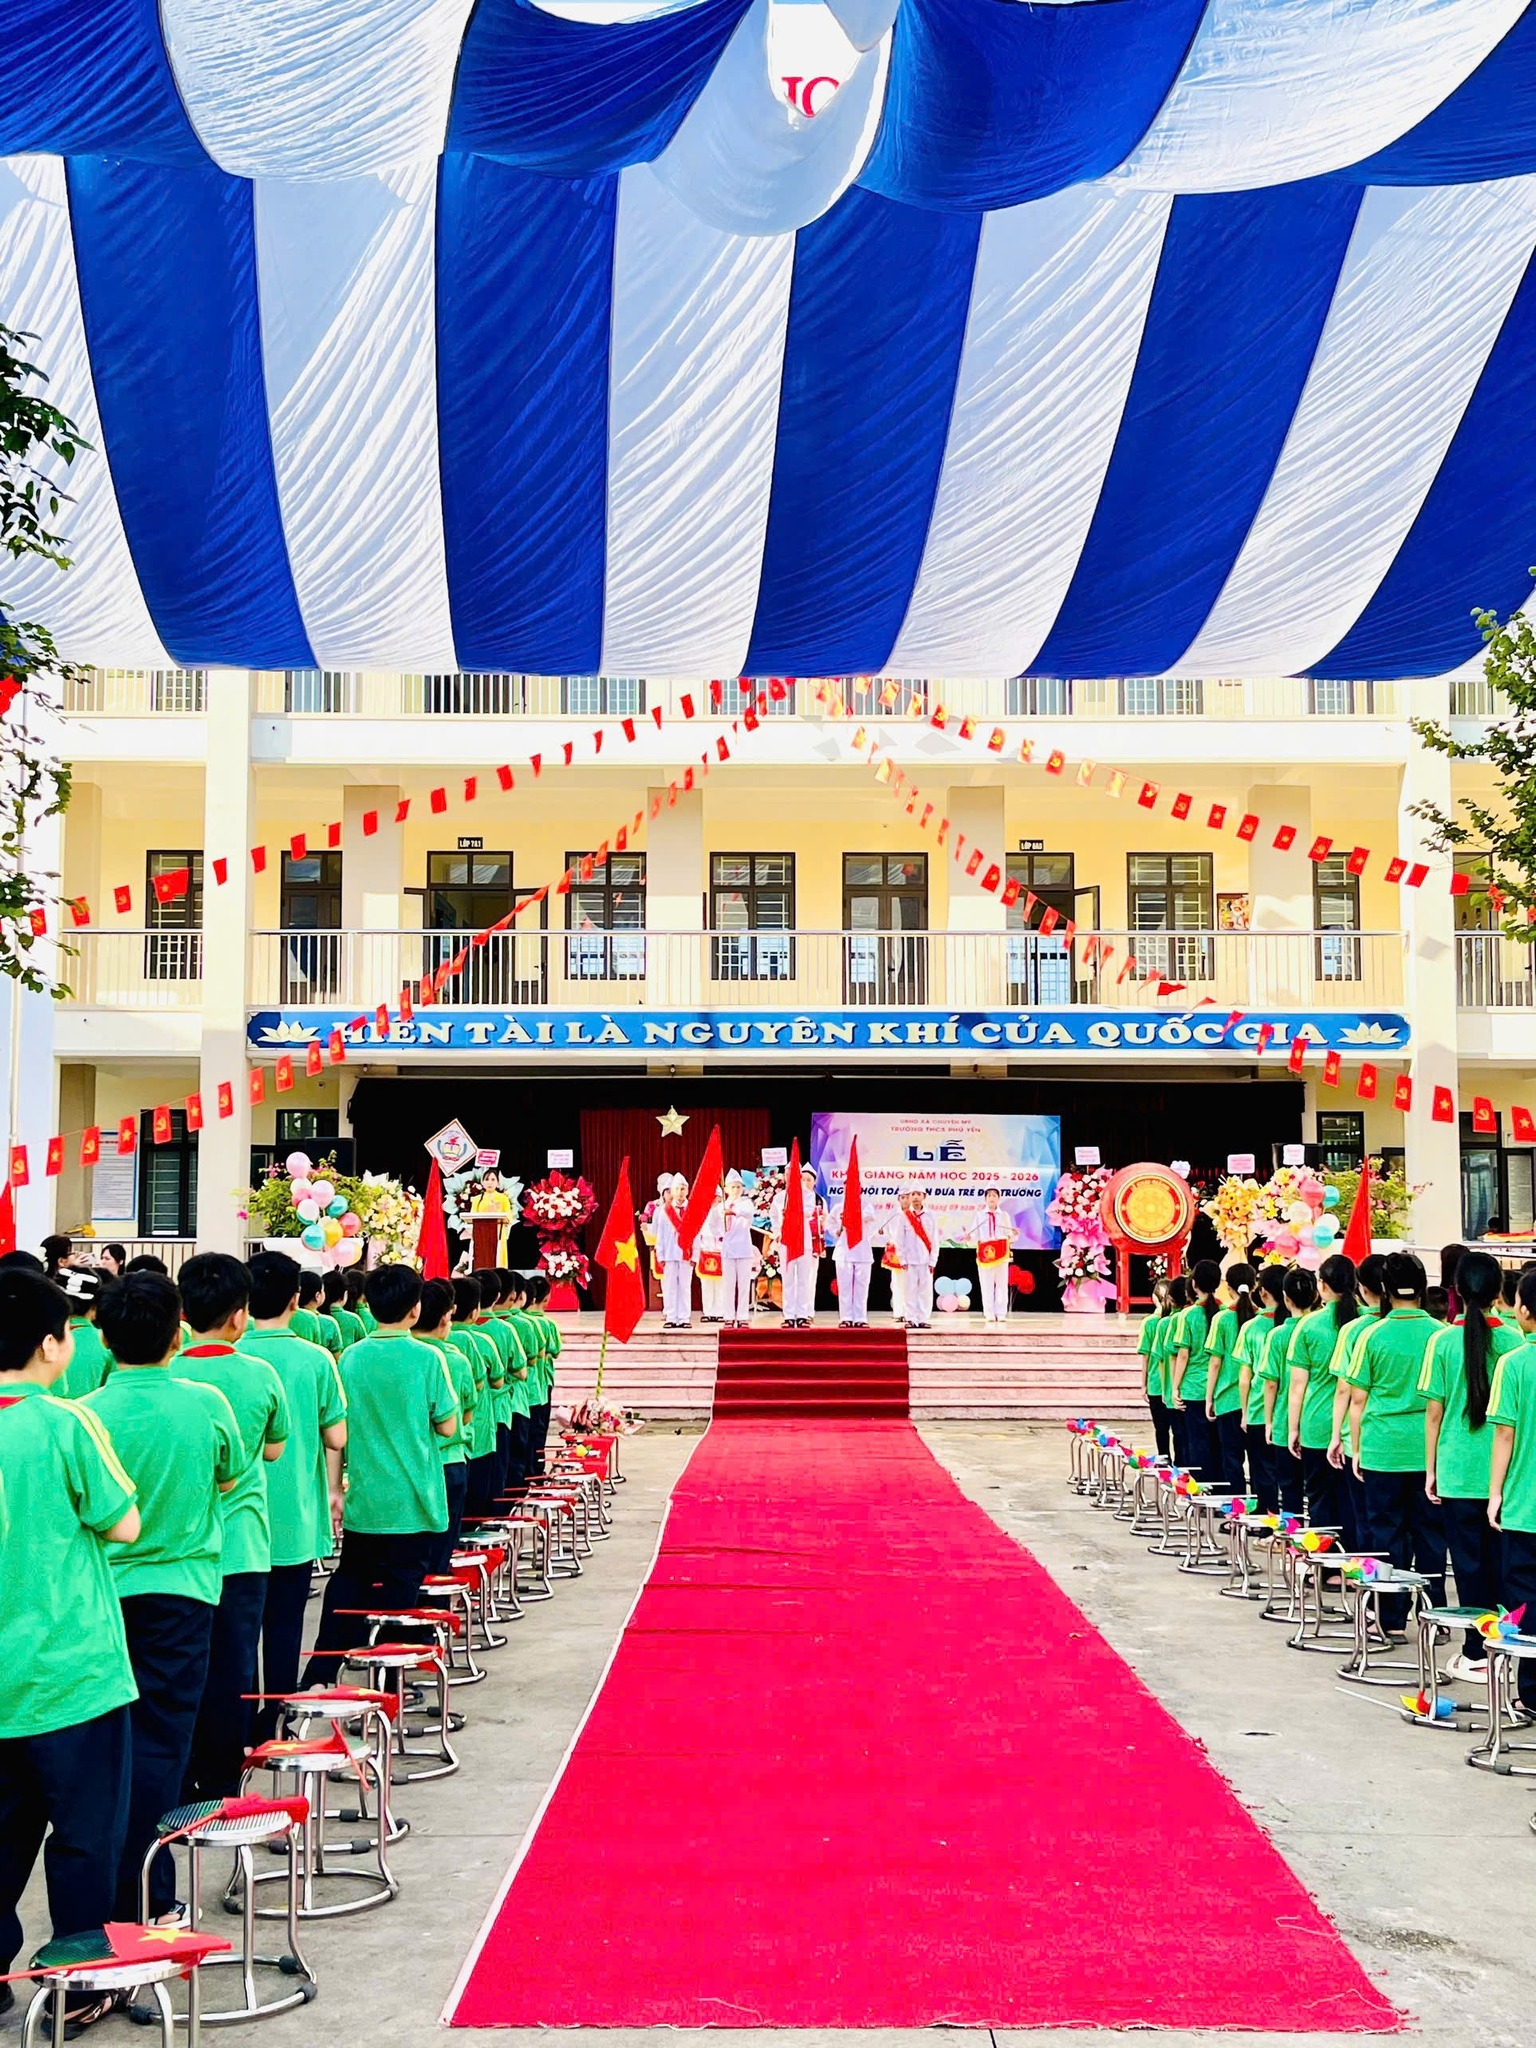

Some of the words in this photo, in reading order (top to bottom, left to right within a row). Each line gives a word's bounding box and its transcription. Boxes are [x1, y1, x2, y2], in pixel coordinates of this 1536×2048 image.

[465, 1015, 554, 1044] TÀI
[564, 1015, 631, 1044] LÀ
[643, 1016, 856, 1044] NGUYÊN
[867, 1015, 960, 1044] KHÍ
[970, 1014, 1077, 1044] CỦA
[1087, 1013, 1224, 1047] QUỐC
[1233, 1022, 1329, 1045] GIA
[906, 1139, 966, 1162] LỄ
[971, 1171, 1000, 1181] 2025
[1010, 1172, 1039, 1181] 2026
